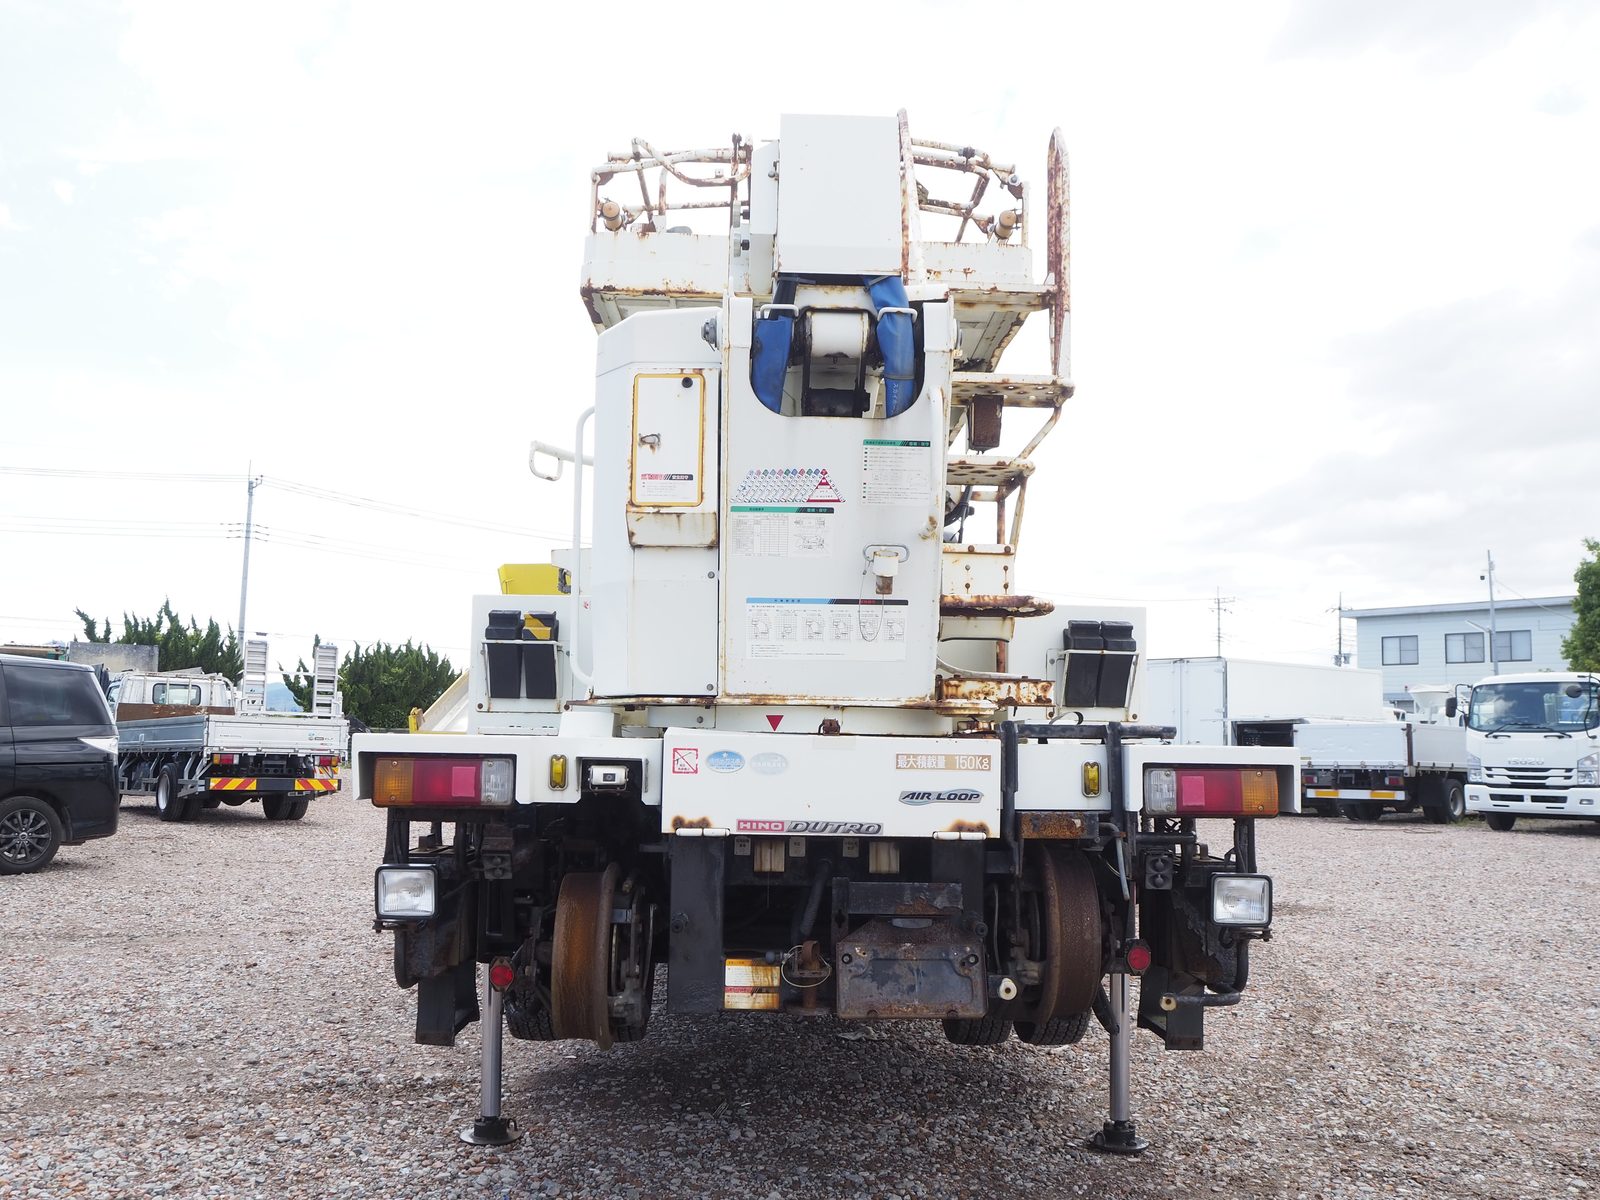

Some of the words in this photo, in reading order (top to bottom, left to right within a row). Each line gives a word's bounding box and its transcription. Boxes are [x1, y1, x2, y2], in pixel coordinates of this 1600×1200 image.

[897, 755, 945, 768] 最大積載量
[955, 756, 990, 770] 150Kg
[1507, 757, 1545, 766] ISUZU
[901, 792, 932, 800] AIR
[936, 792, 980, 801] LOOP
[739, 821, 783, 831] HINO
[786, 821, 882, 835] DUTRO
